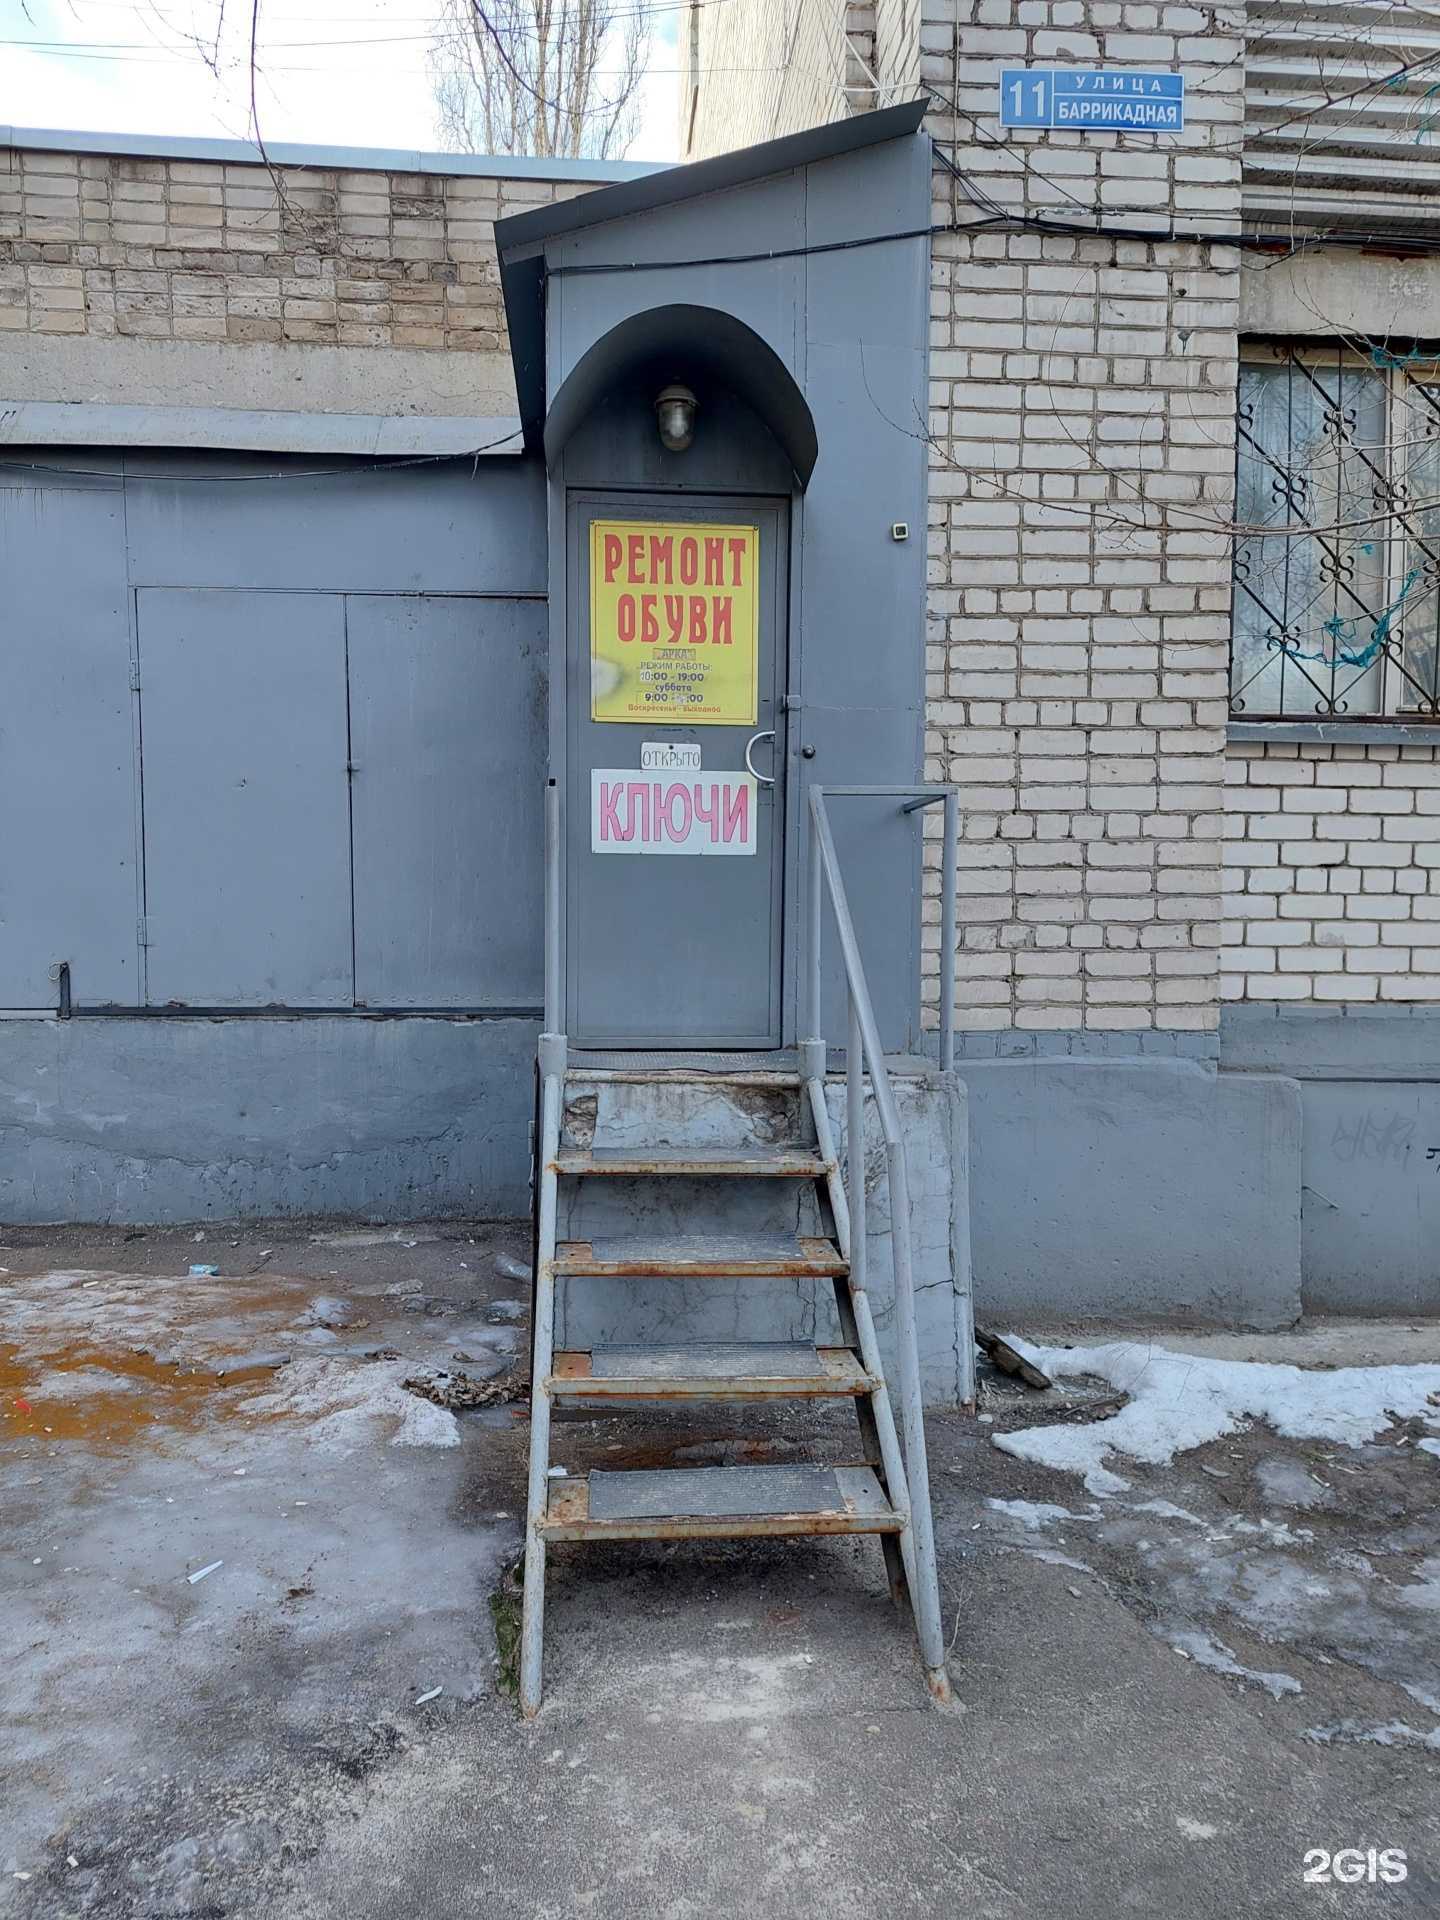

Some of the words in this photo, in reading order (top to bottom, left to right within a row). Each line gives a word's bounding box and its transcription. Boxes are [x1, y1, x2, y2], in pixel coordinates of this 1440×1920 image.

[1075, 76, 1162, 94] УЛИЦА
[1009, 80, 1046, 117] 11
[1058, 102, 1177, 125] БАРРИКАДНАЯ
[604, 534, 746, 586] РЕМОНТ
[617, 593, 733, 644] ОБУВИ
[640, 661, 672, 670] РЕЖИМ
[675, 662, 713, 671] РАБОТЫ:
[640, 671, 668, 681] 10:00
[678, 673, 704, 681] 19:00
[655, 683, 692, 692] суббота
[645, 693, 668, 702] 9:00
[642, 750, 700, 767] ОТКРЫТО
[600, 782, 749, 843] КЛЮЧИ
